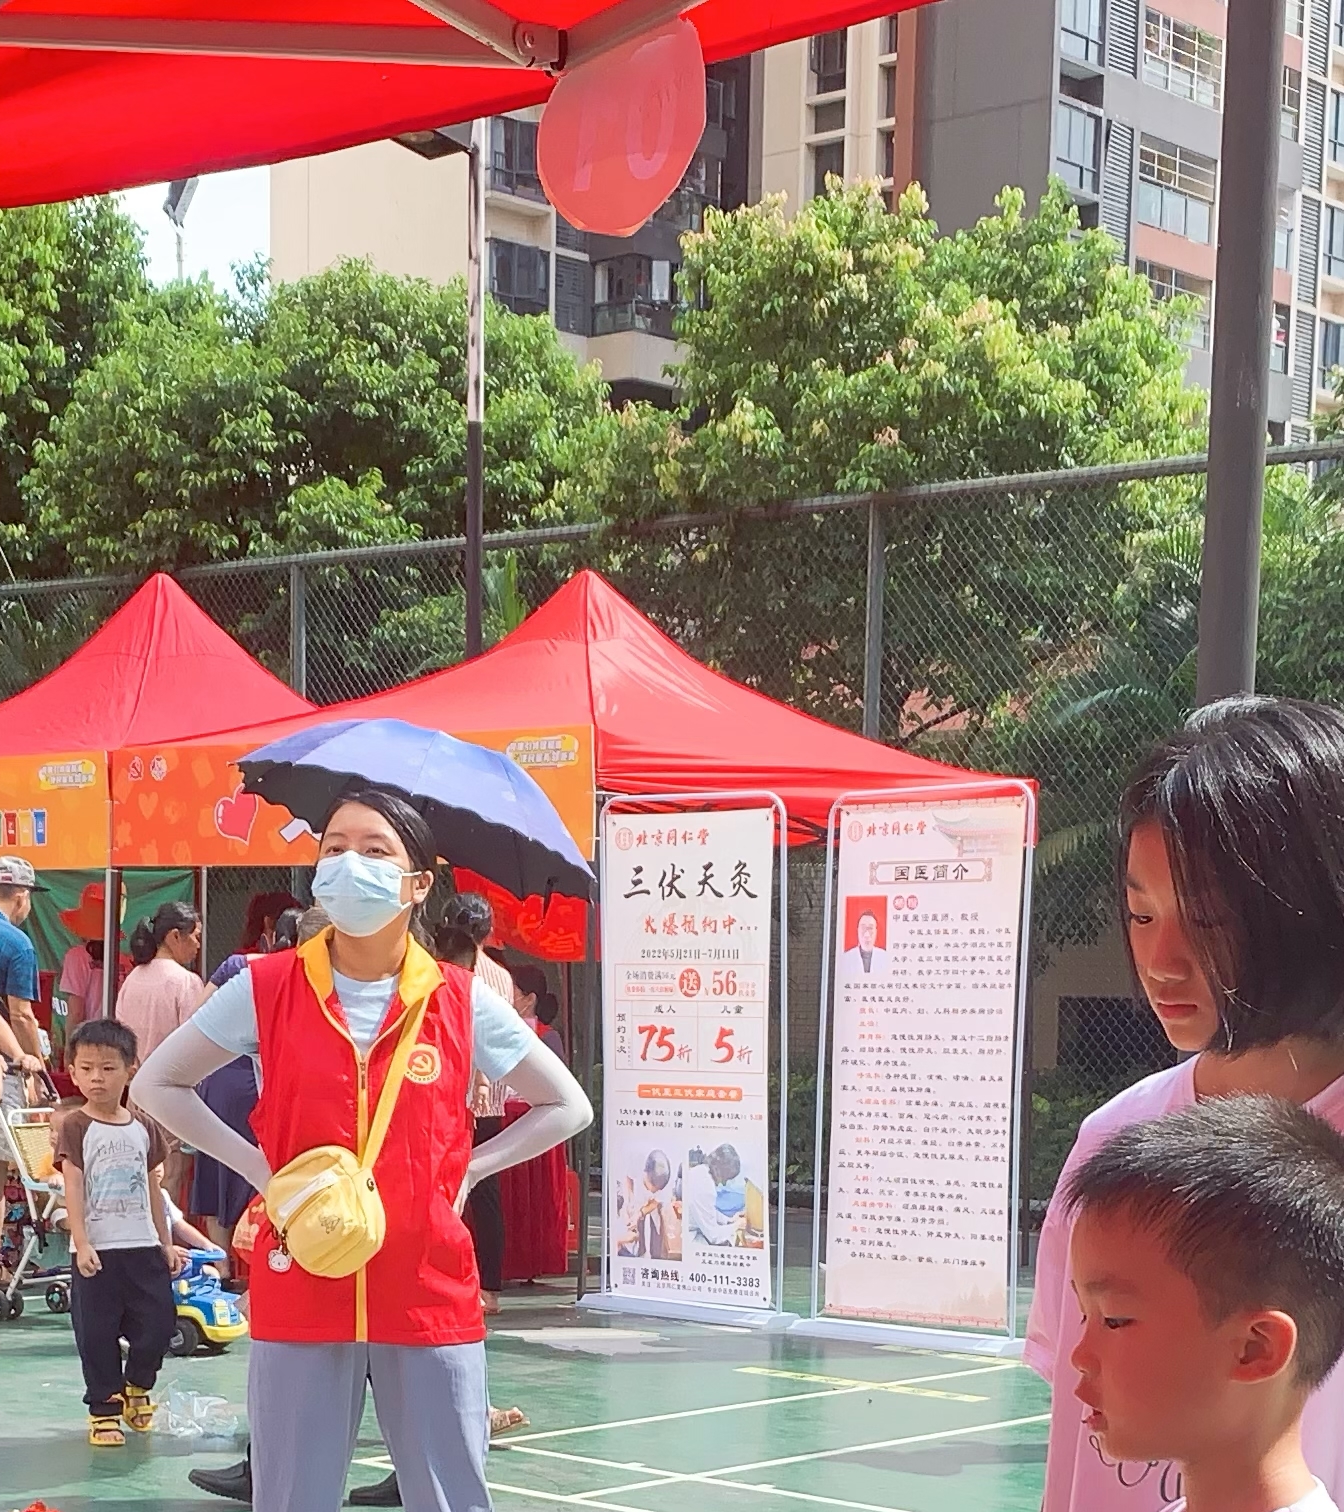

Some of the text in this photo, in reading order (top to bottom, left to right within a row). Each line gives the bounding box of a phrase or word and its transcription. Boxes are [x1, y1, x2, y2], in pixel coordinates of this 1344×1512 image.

[636, 828, 709, 847] 北京同仁堂
[866, 820, 927, 838] 北京同仁堂
[623, 860, 758, 900] 三伏天灸
[894, 863, 969, 881] 国医简介
[681, 971, 700, 994] 送
[654, 1005, 676, 1014] 成人
[721, 1005, 744, 1014] 儿童
[616, 1013, 627, 1054] 预约3次
[689, 1273, 760, 1288] 400-111-3383
